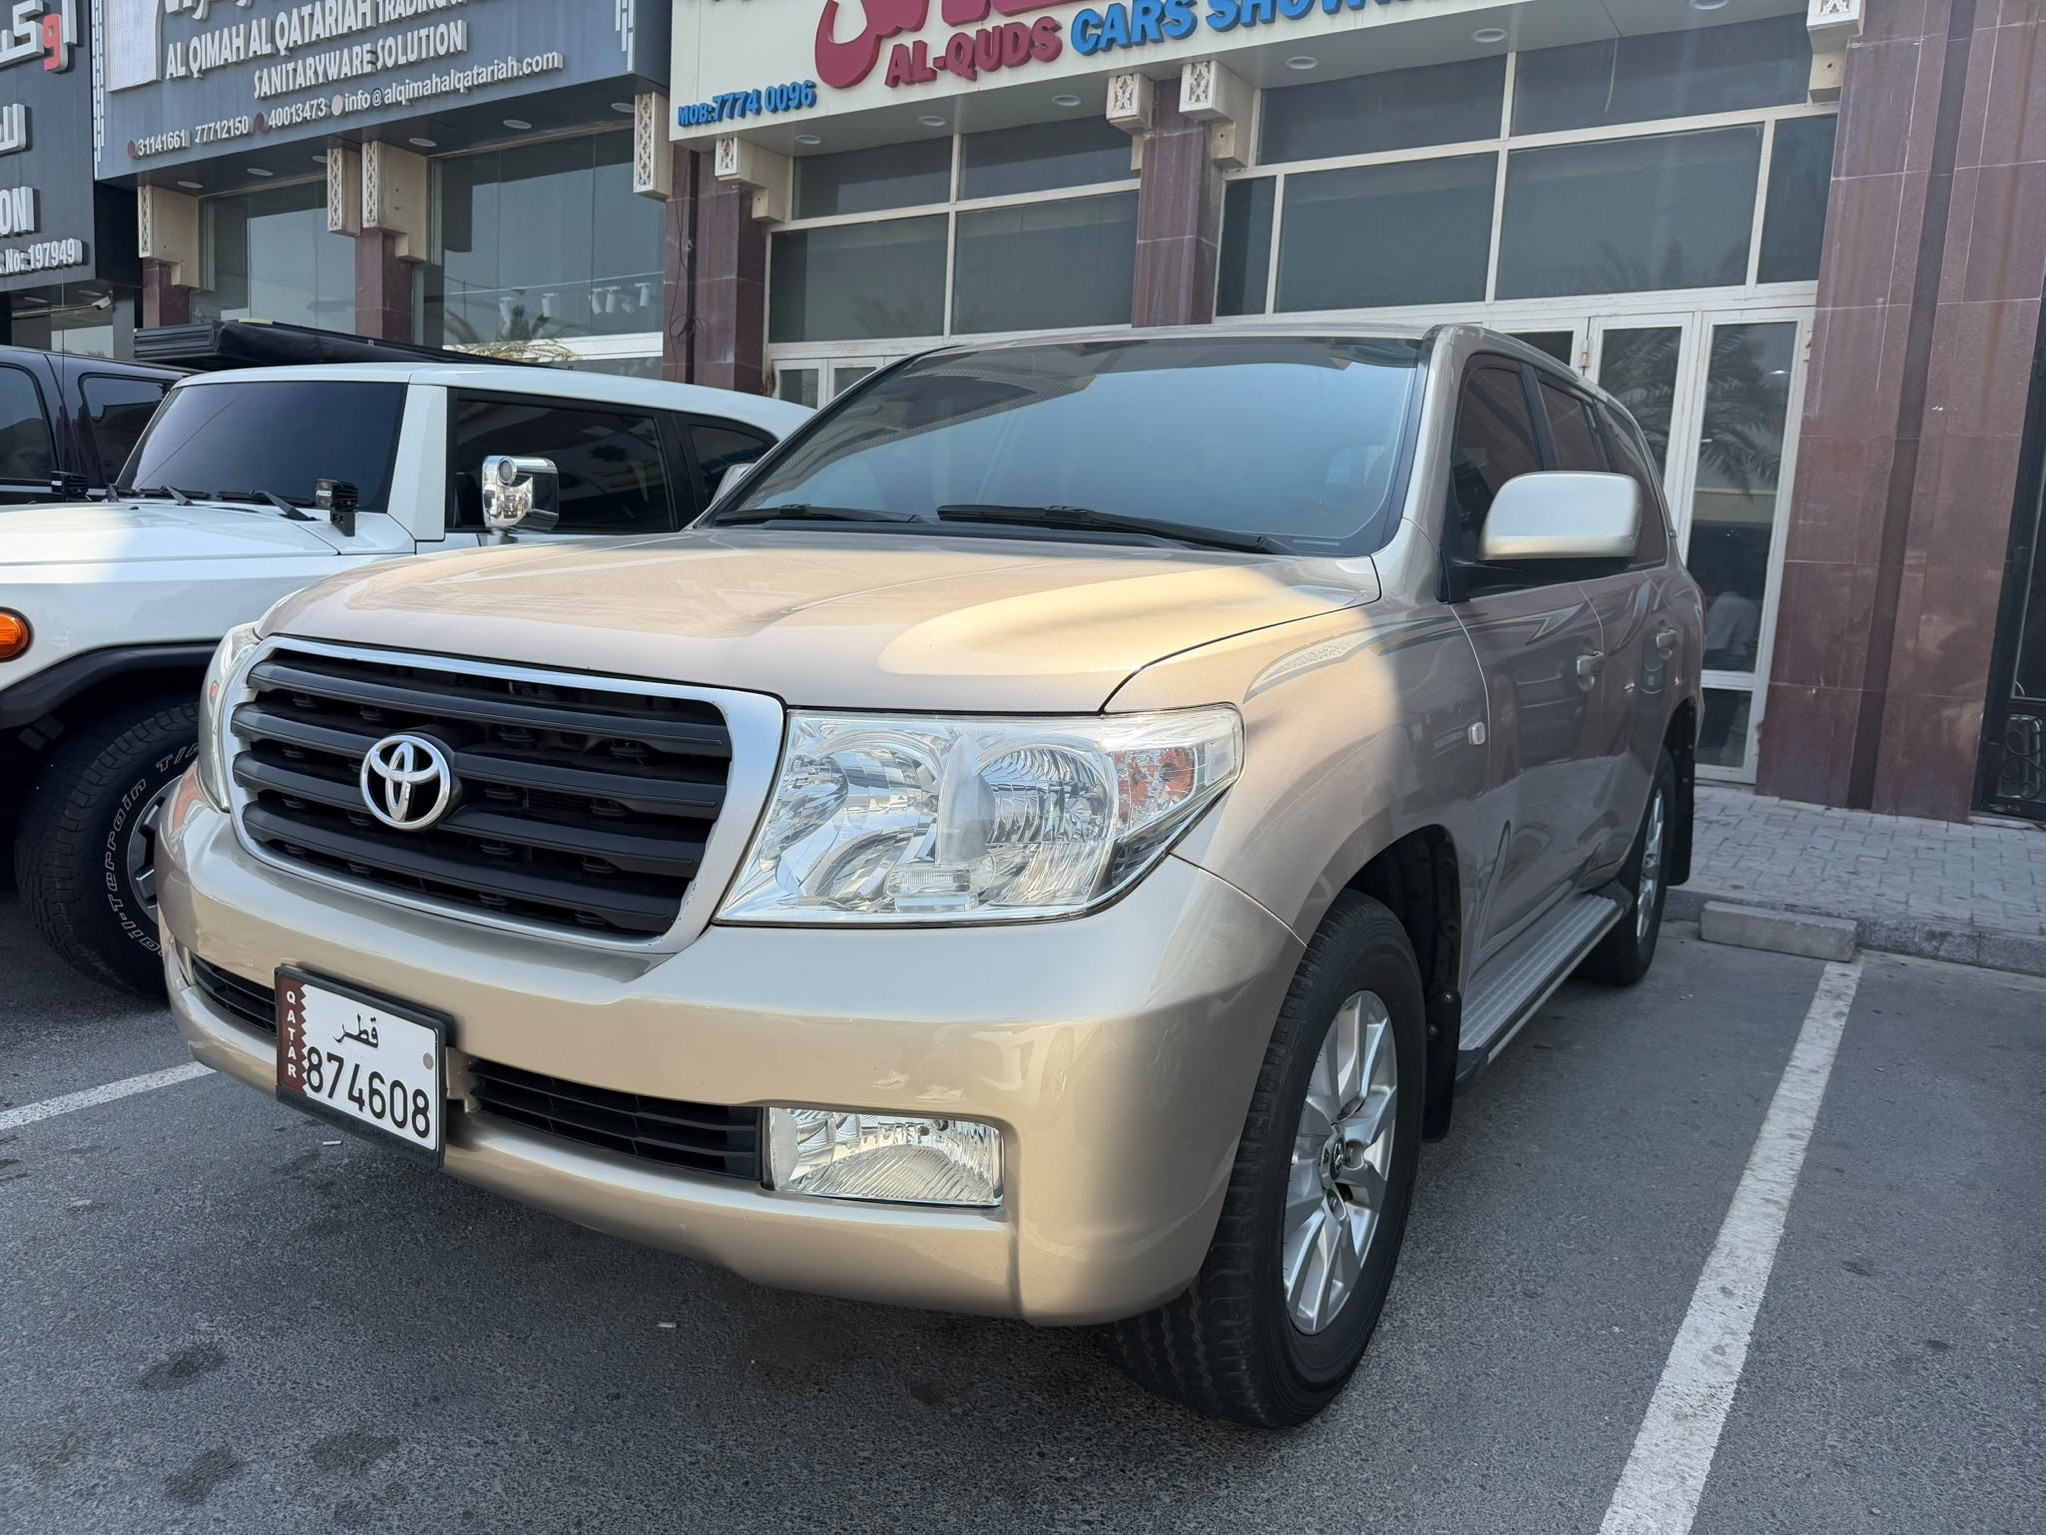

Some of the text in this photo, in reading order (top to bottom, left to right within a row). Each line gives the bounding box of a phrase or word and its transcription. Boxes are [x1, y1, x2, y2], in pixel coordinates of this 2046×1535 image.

[166, 42, 187, 80] AL
[189, 24, 246, 79] QIMAH
[249, 18, 272, 57] AL
[275, 0, 373, 56] QATARIAH
[254, 19, 464, 99] SANITARYWARE SOLUTION
[885, 16, 1062, 89] AL-QUDS
[1071, 0, 1198, 57] CARS
[138, 129, 187, 157] 31141661
[195, 115, 249, 144] 77712150
[268, 98, 326, 129] 40013473
[764, 80, 817, 114] 0096
[285, 990, 298, 1079] QATAR
[332, 1012, 380, 1049] قطر
[306, 1046, 431, 1139] 874608
